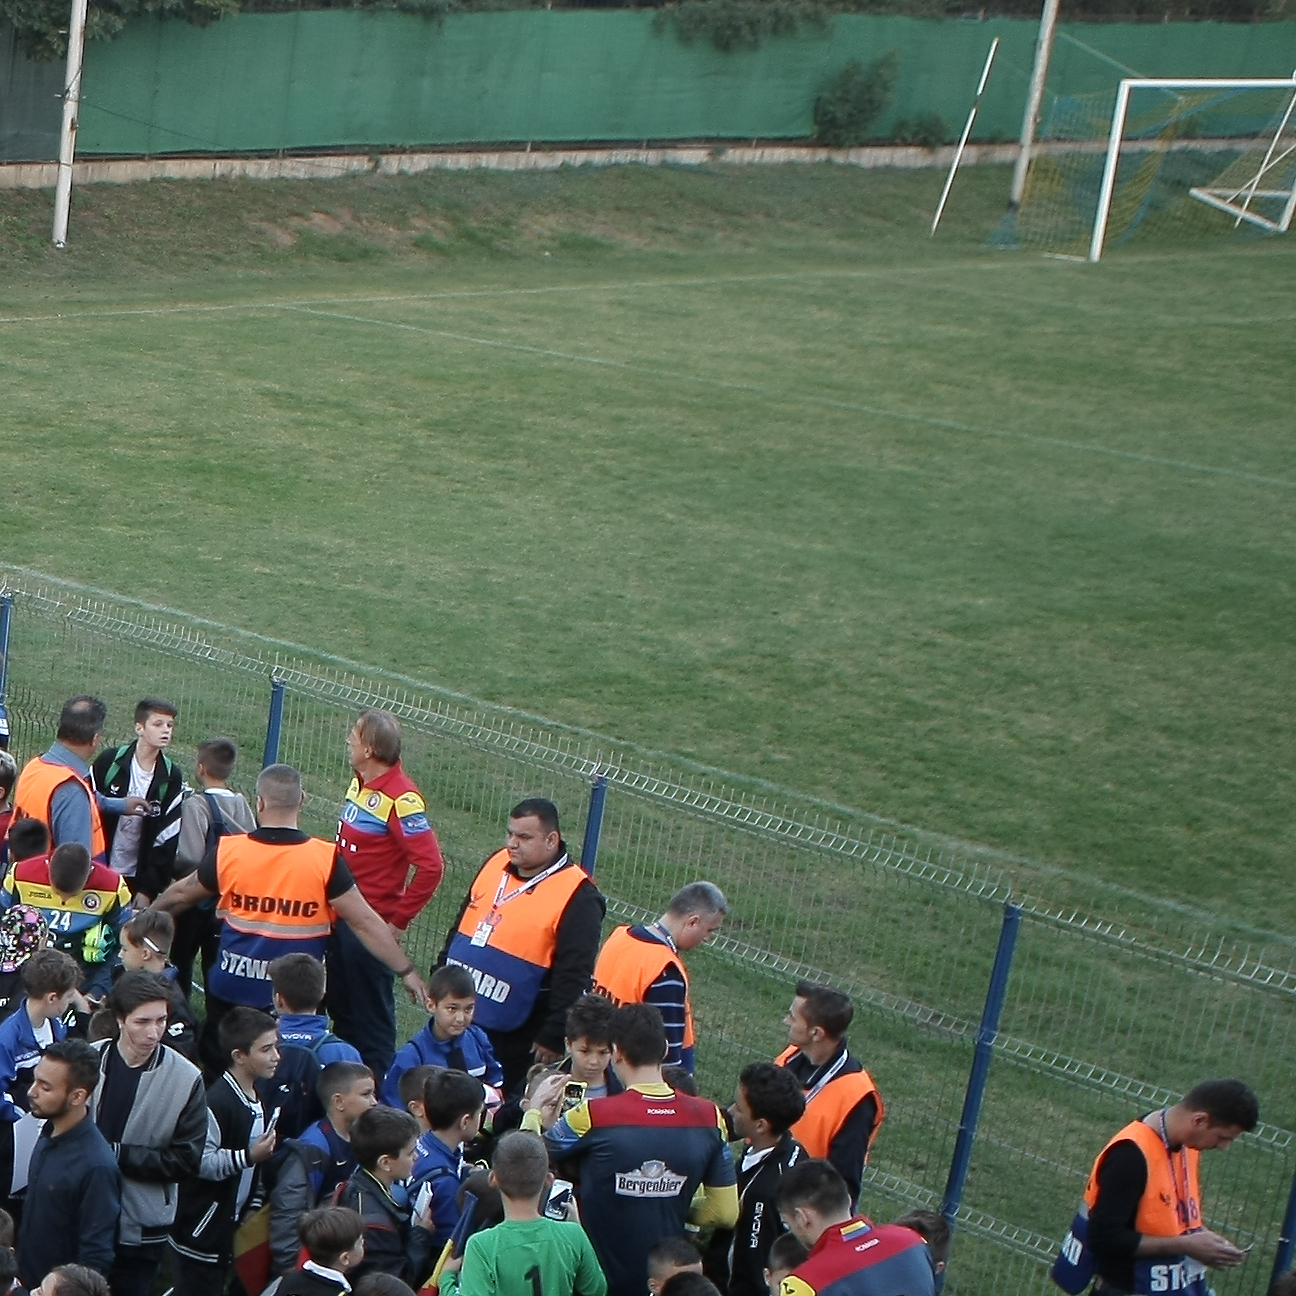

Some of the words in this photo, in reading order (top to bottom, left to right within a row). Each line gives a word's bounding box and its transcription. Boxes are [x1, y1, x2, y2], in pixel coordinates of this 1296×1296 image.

[231, 892, 319, 919] BRONIC
[49, 909, 72, 931] 24
[618, 1176, 682, 1194] Bergenbier
[749, 1200, 765, 1249] GIVOVA
